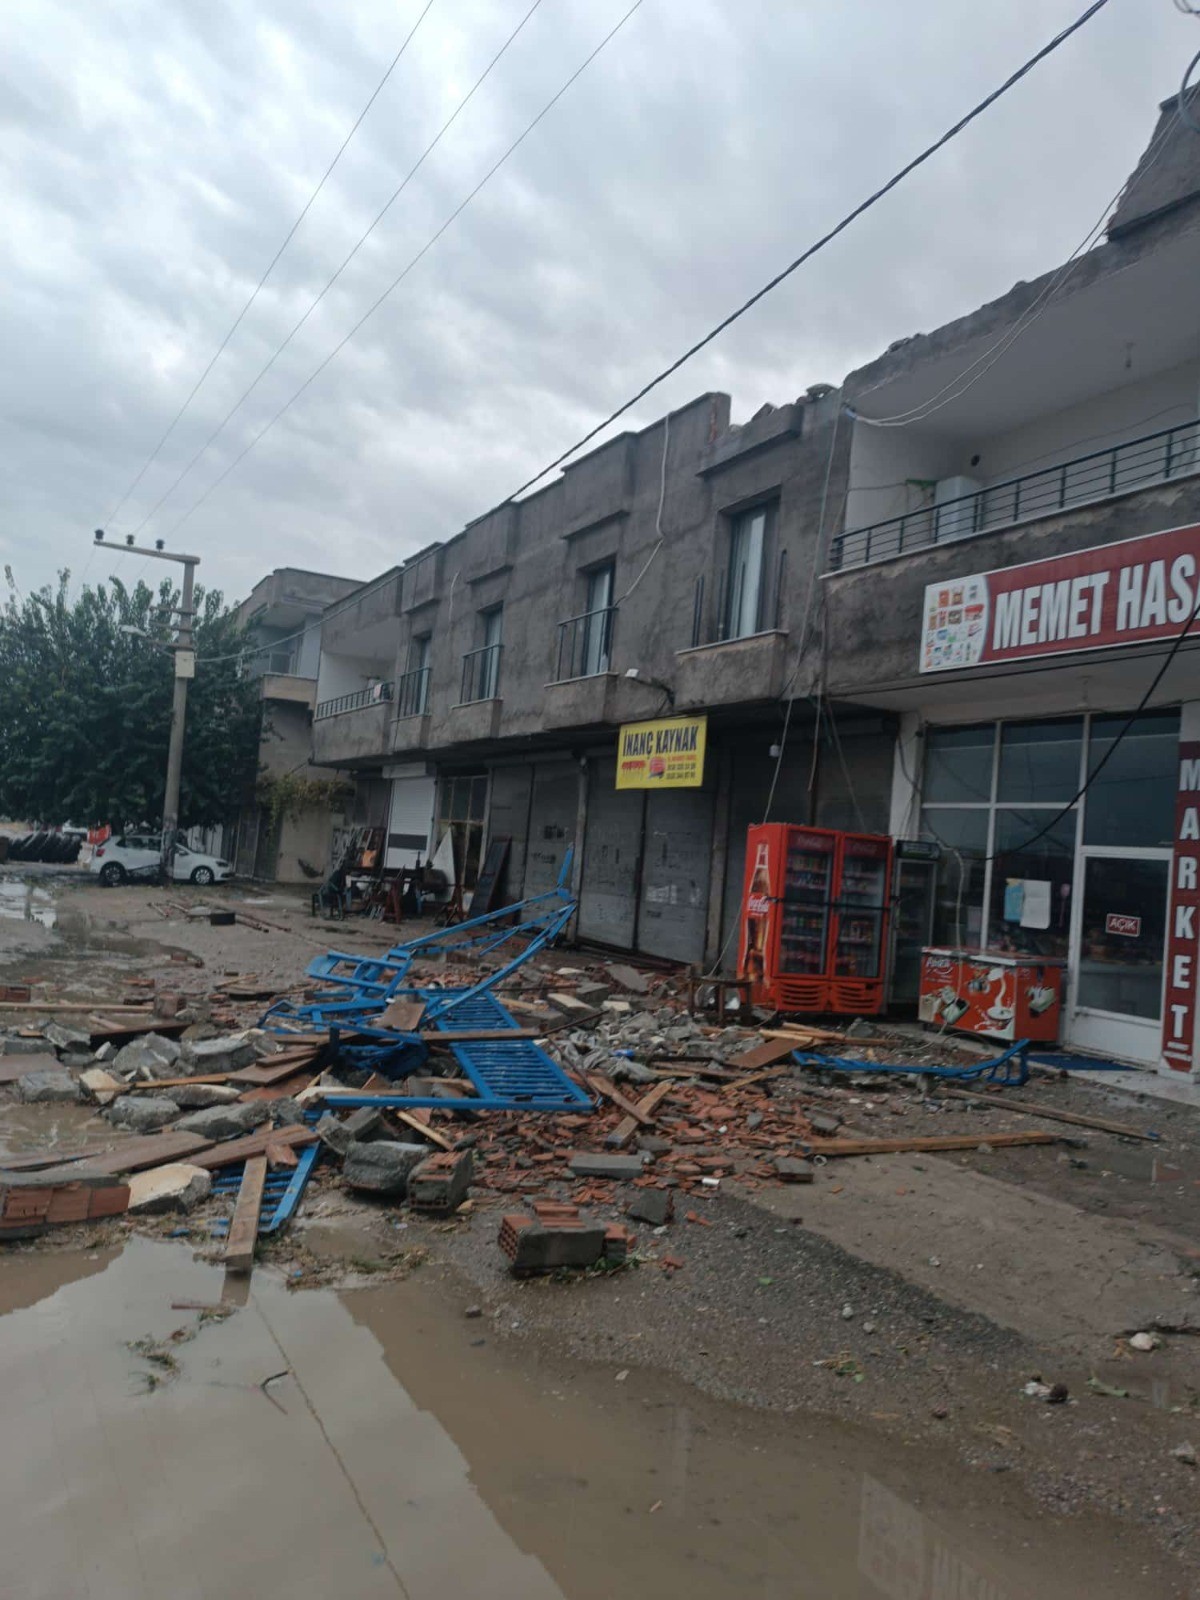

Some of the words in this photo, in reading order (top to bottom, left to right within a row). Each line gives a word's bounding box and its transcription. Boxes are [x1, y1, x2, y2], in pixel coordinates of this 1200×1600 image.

[993, 571, 1111, 651] MEMET
[1116, 554, 1200, 632] HAS
[623, 729, 654, 760] İNANÇ
[656, 725, 699, 754] KAYNAK
[1109, 918, 1137, 931] AÇIK
[1171, 758, 1200, 1038] MARKET
